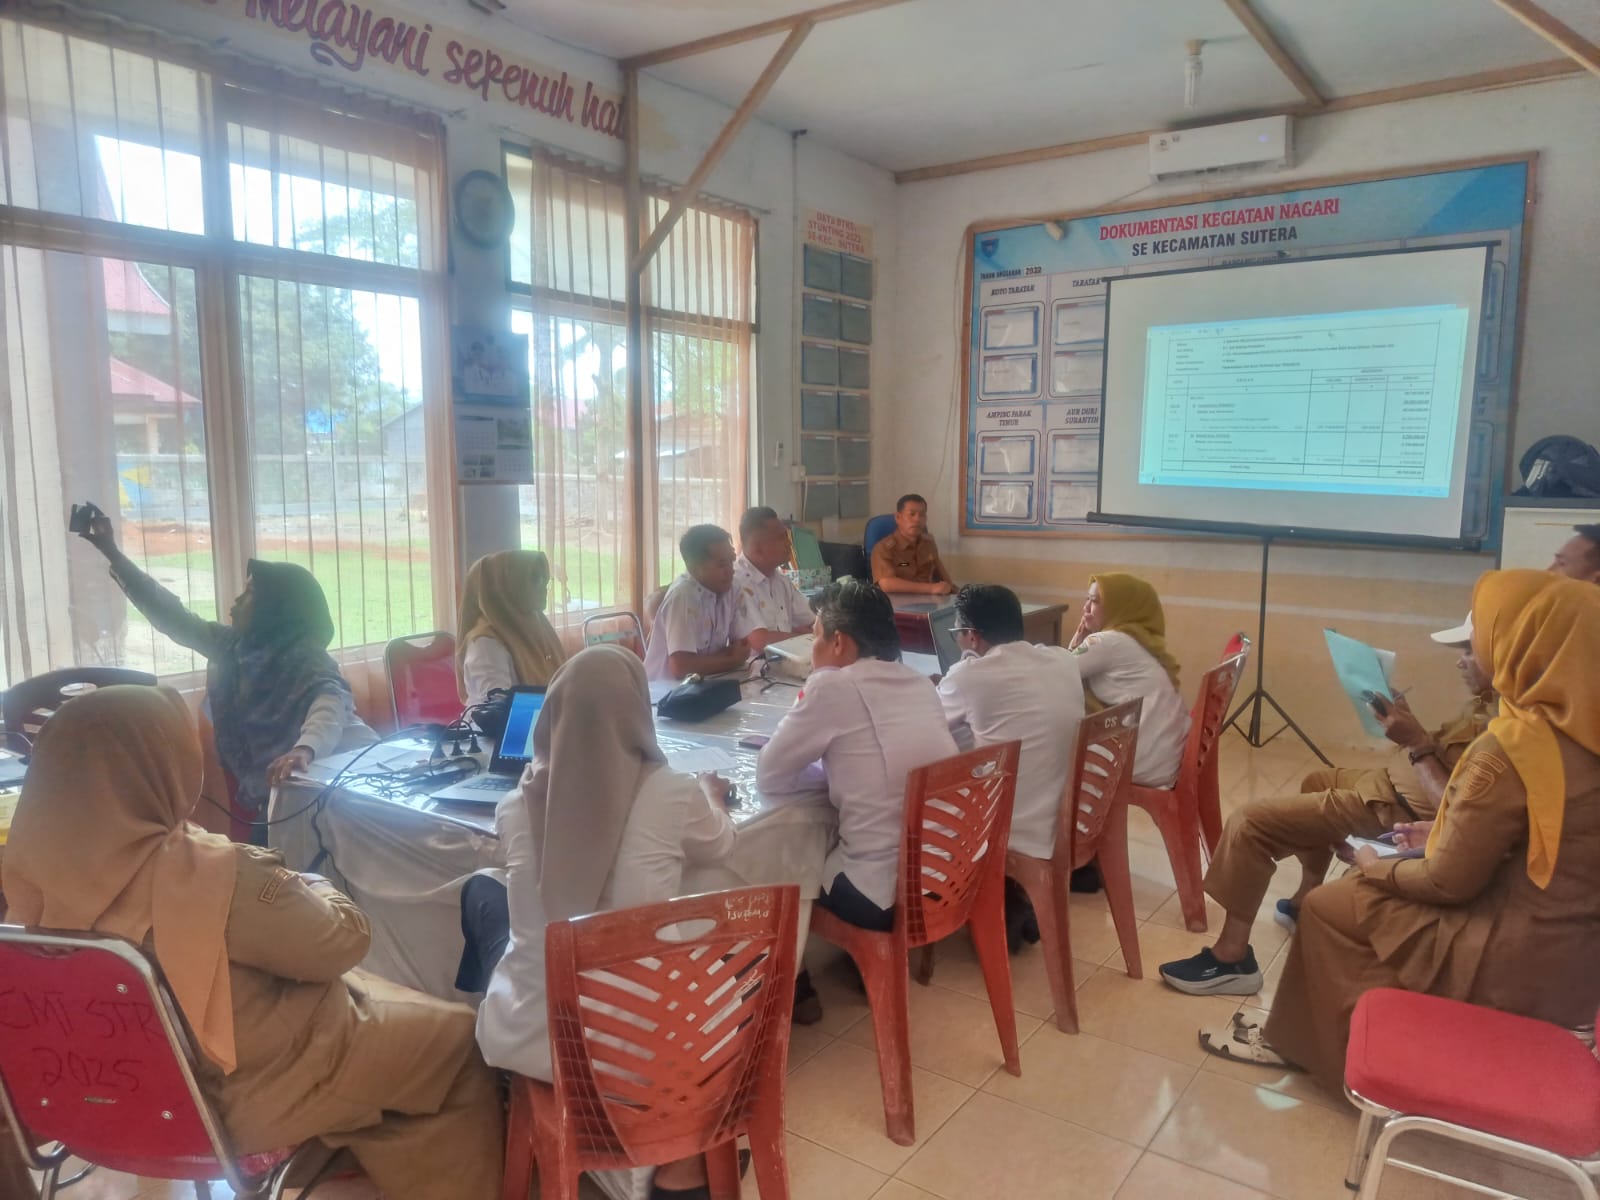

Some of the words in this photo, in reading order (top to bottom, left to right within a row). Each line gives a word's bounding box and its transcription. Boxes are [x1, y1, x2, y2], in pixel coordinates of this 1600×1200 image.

[1100, 214, 1199, 240] DOKUMENTASI
[1202, 205, 1275, 228] KEGIATAN
[1279, 198, 1340, 219] NAGARI
[1132, 242, 1148, 257] SE
[1153, 232, 1236, 254] KECAMATAN
[1241, 226, 1298, 245] SUTERA
[32, 1046, 143, 1092] 2025
